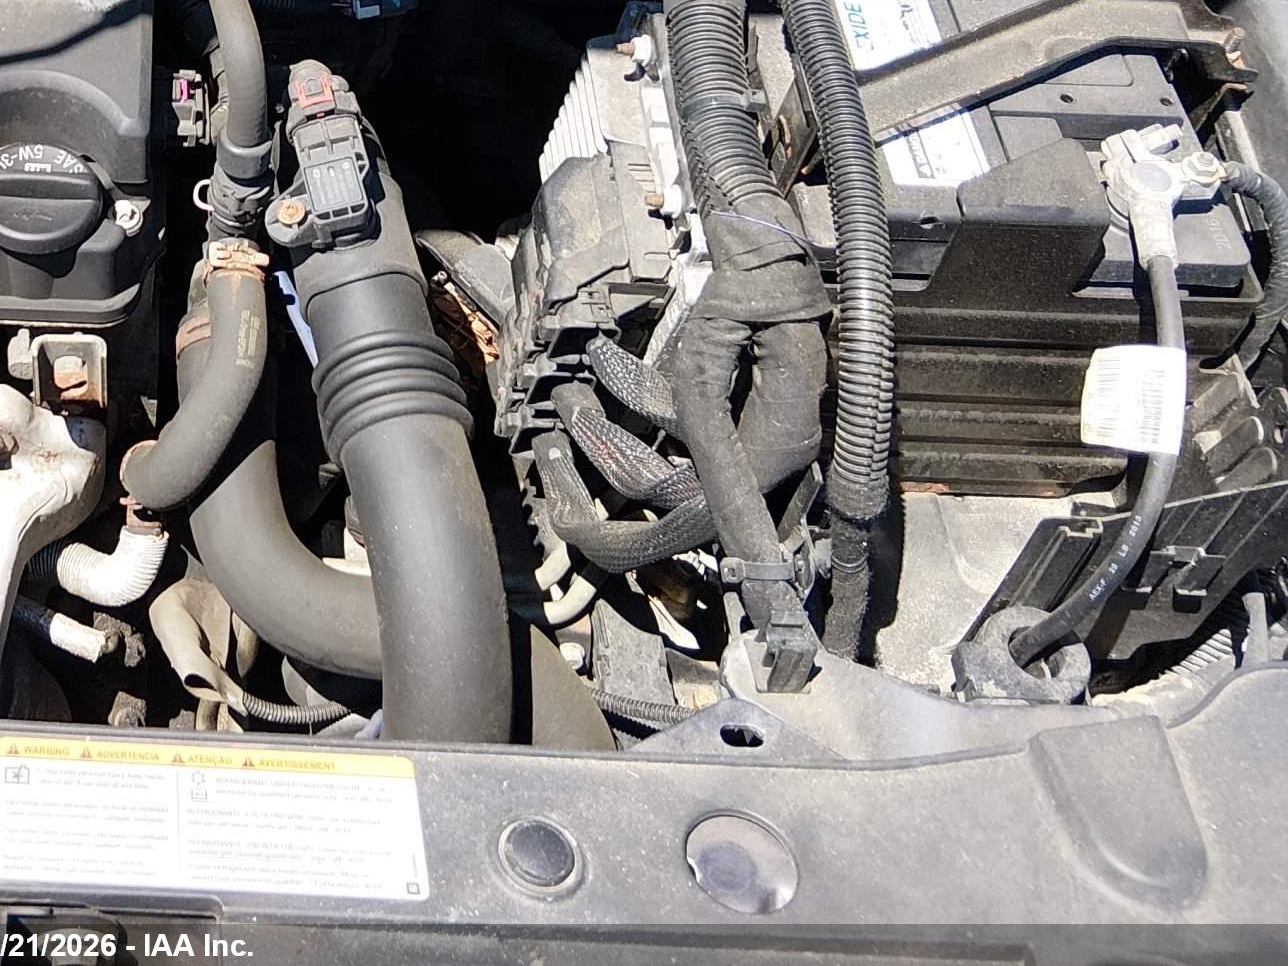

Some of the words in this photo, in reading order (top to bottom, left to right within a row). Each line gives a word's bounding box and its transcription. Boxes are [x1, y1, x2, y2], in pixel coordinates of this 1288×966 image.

[54, 150, 84, 174] SAE
[1129, 515, 1143, 537] 2013
[23, 745, 70, 757] WARNING
[96, 748, 160, 762] ADVERTENCIA
[187, 753, 233, 767] ATENÇÃO
[258, 758, 335, 771] AVERTISSEMENT
